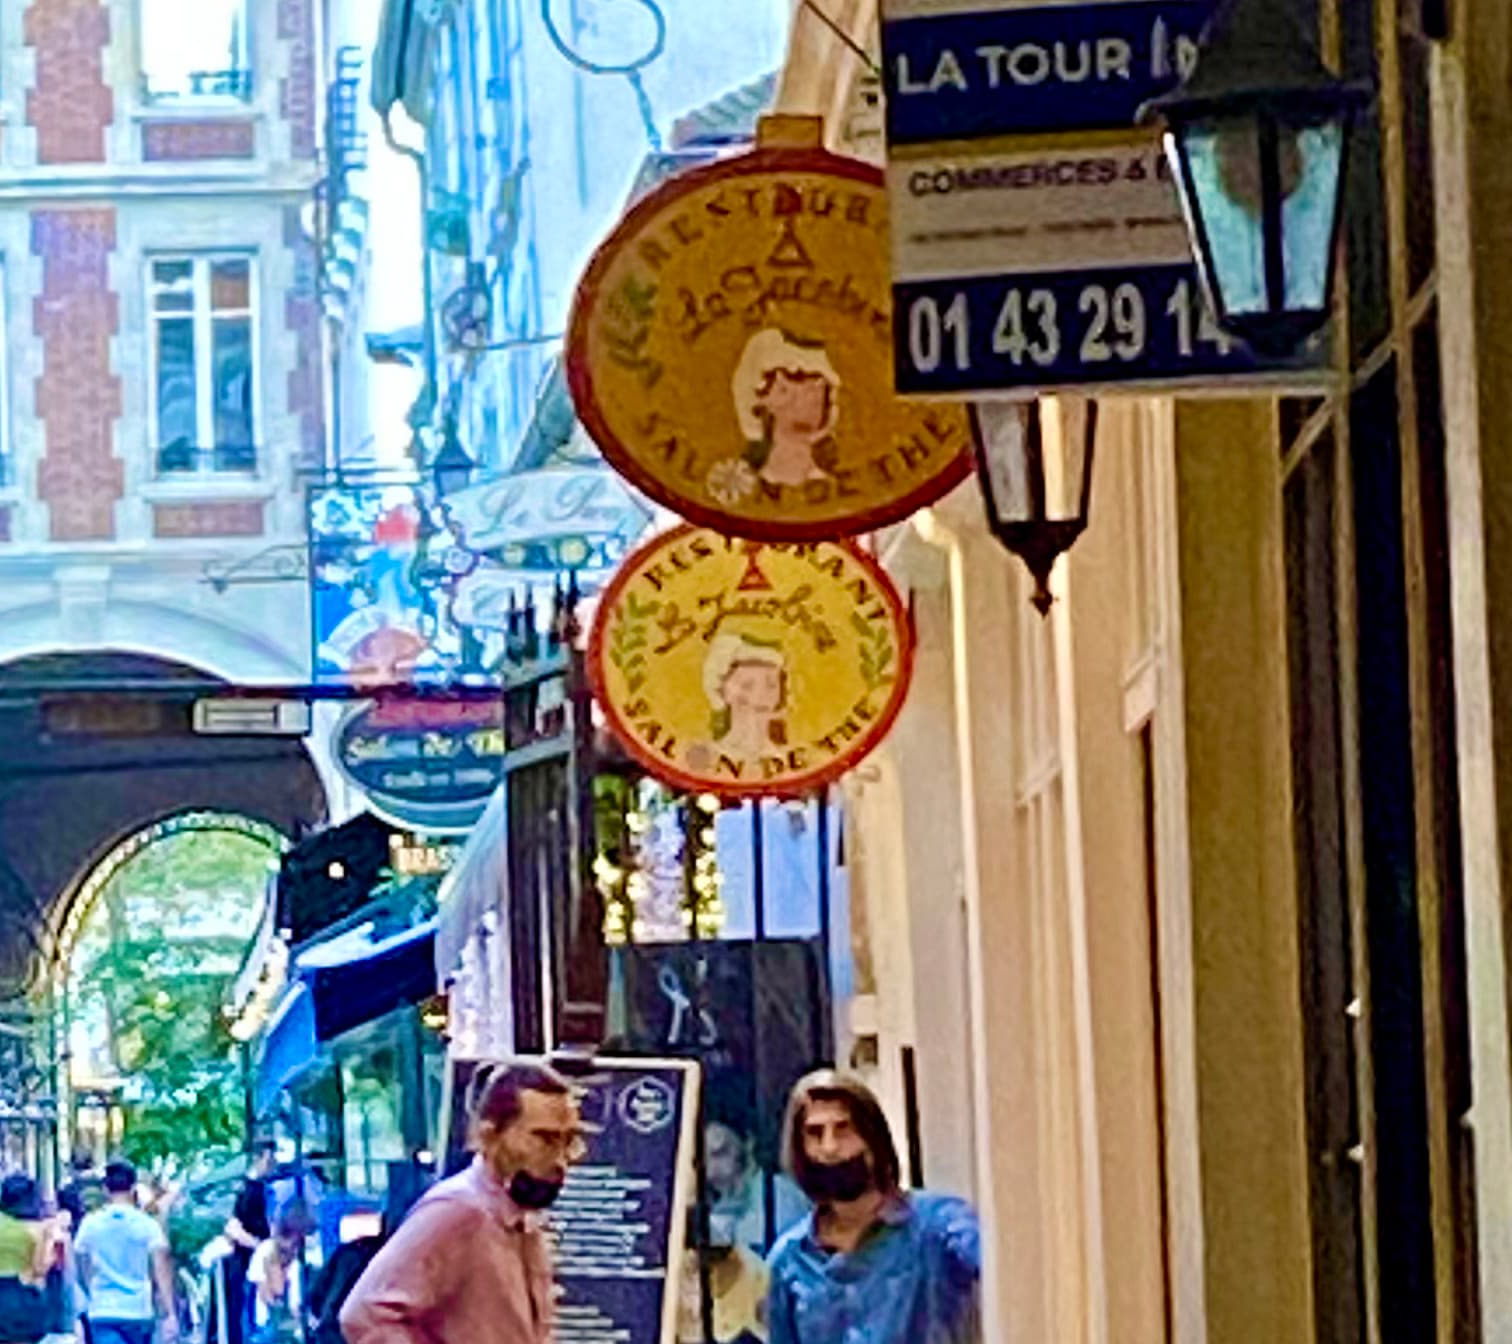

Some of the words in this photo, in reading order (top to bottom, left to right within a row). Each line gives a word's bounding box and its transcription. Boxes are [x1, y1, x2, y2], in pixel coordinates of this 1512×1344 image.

[896, 51, 968, 95] LA
[974, 37, 1130, 87] TOUR
[909, 157, 1116, 197] COMMERCES
[908, 290, 970, 371] 01
[993, 286, 1060, 367] 43
[1079, 283, 1144, 363] 29
[758, 747, 808, 779] DE
